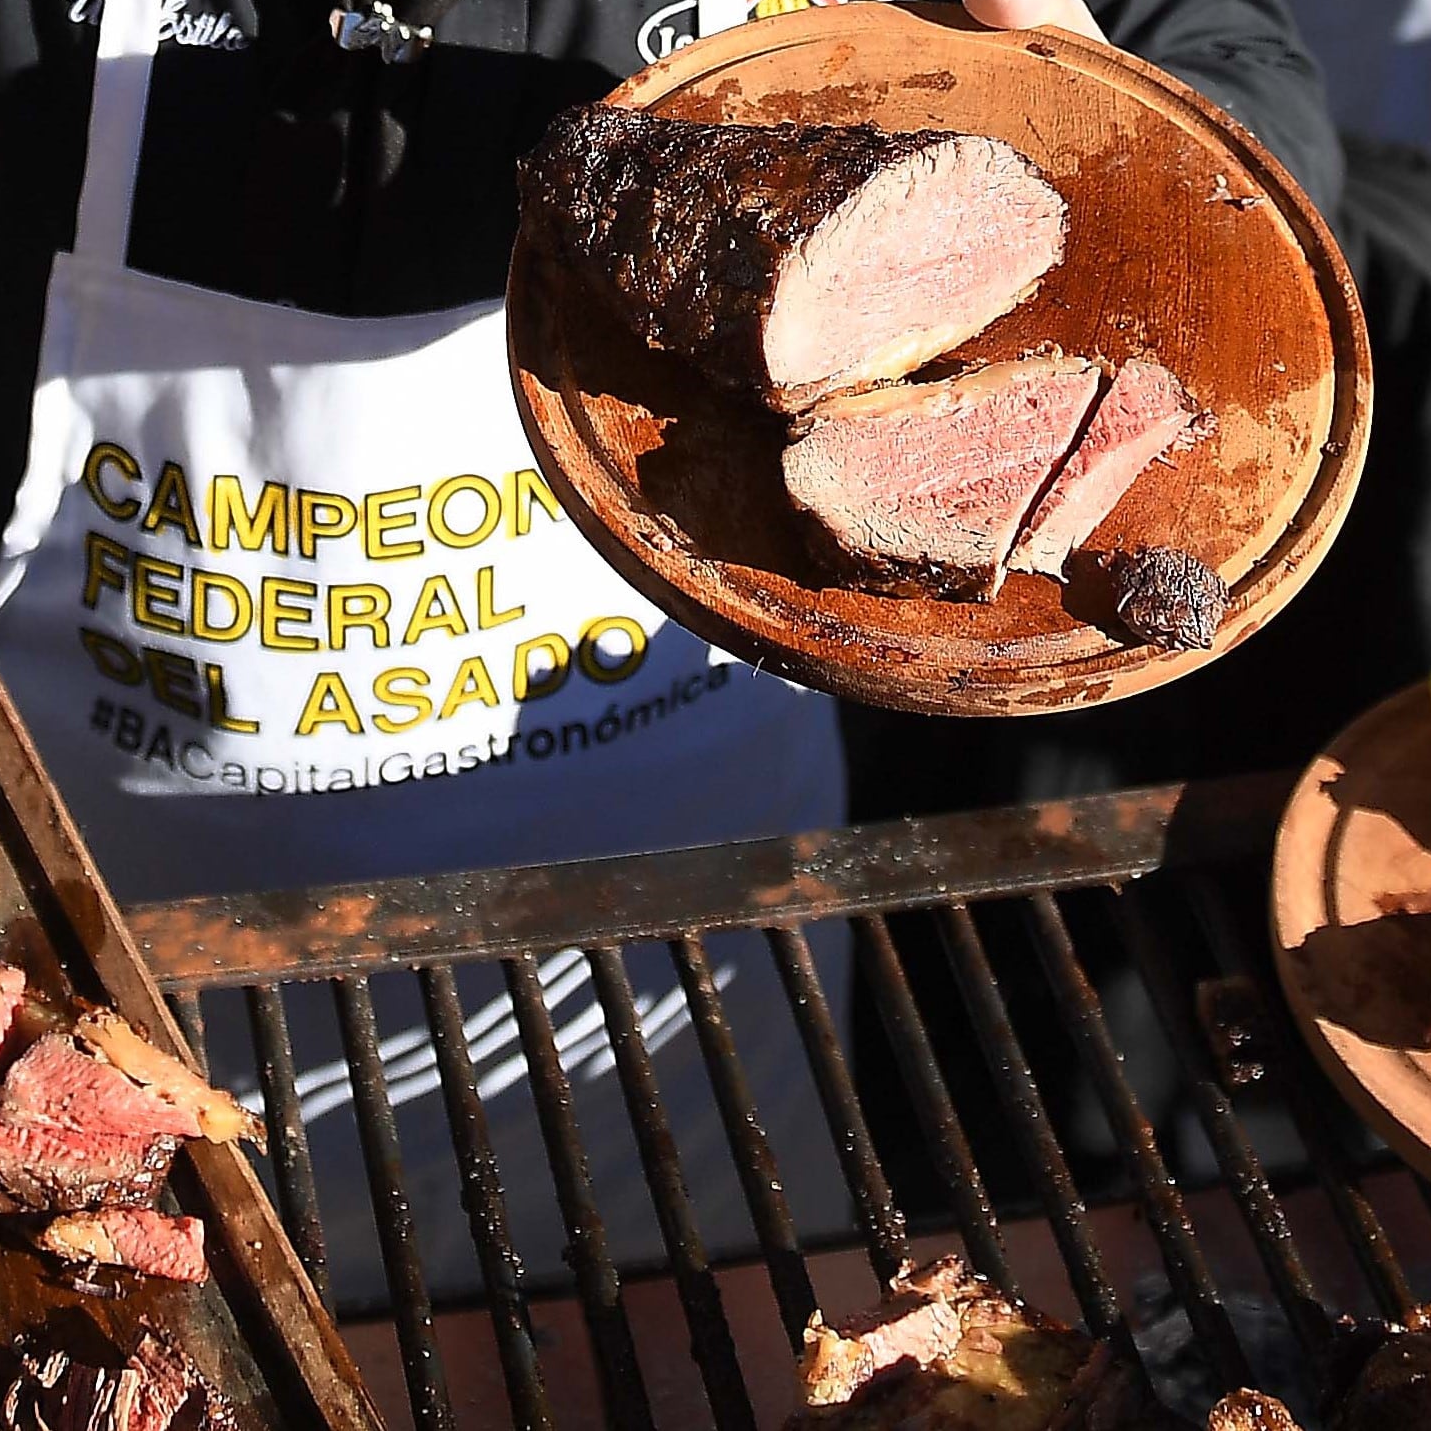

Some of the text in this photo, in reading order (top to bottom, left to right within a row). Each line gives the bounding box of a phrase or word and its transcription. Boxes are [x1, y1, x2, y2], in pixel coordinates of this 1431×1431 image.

[83, 531, 525, 652] FEDERAL
[80, 615, 647, 737] DEL ASADO
